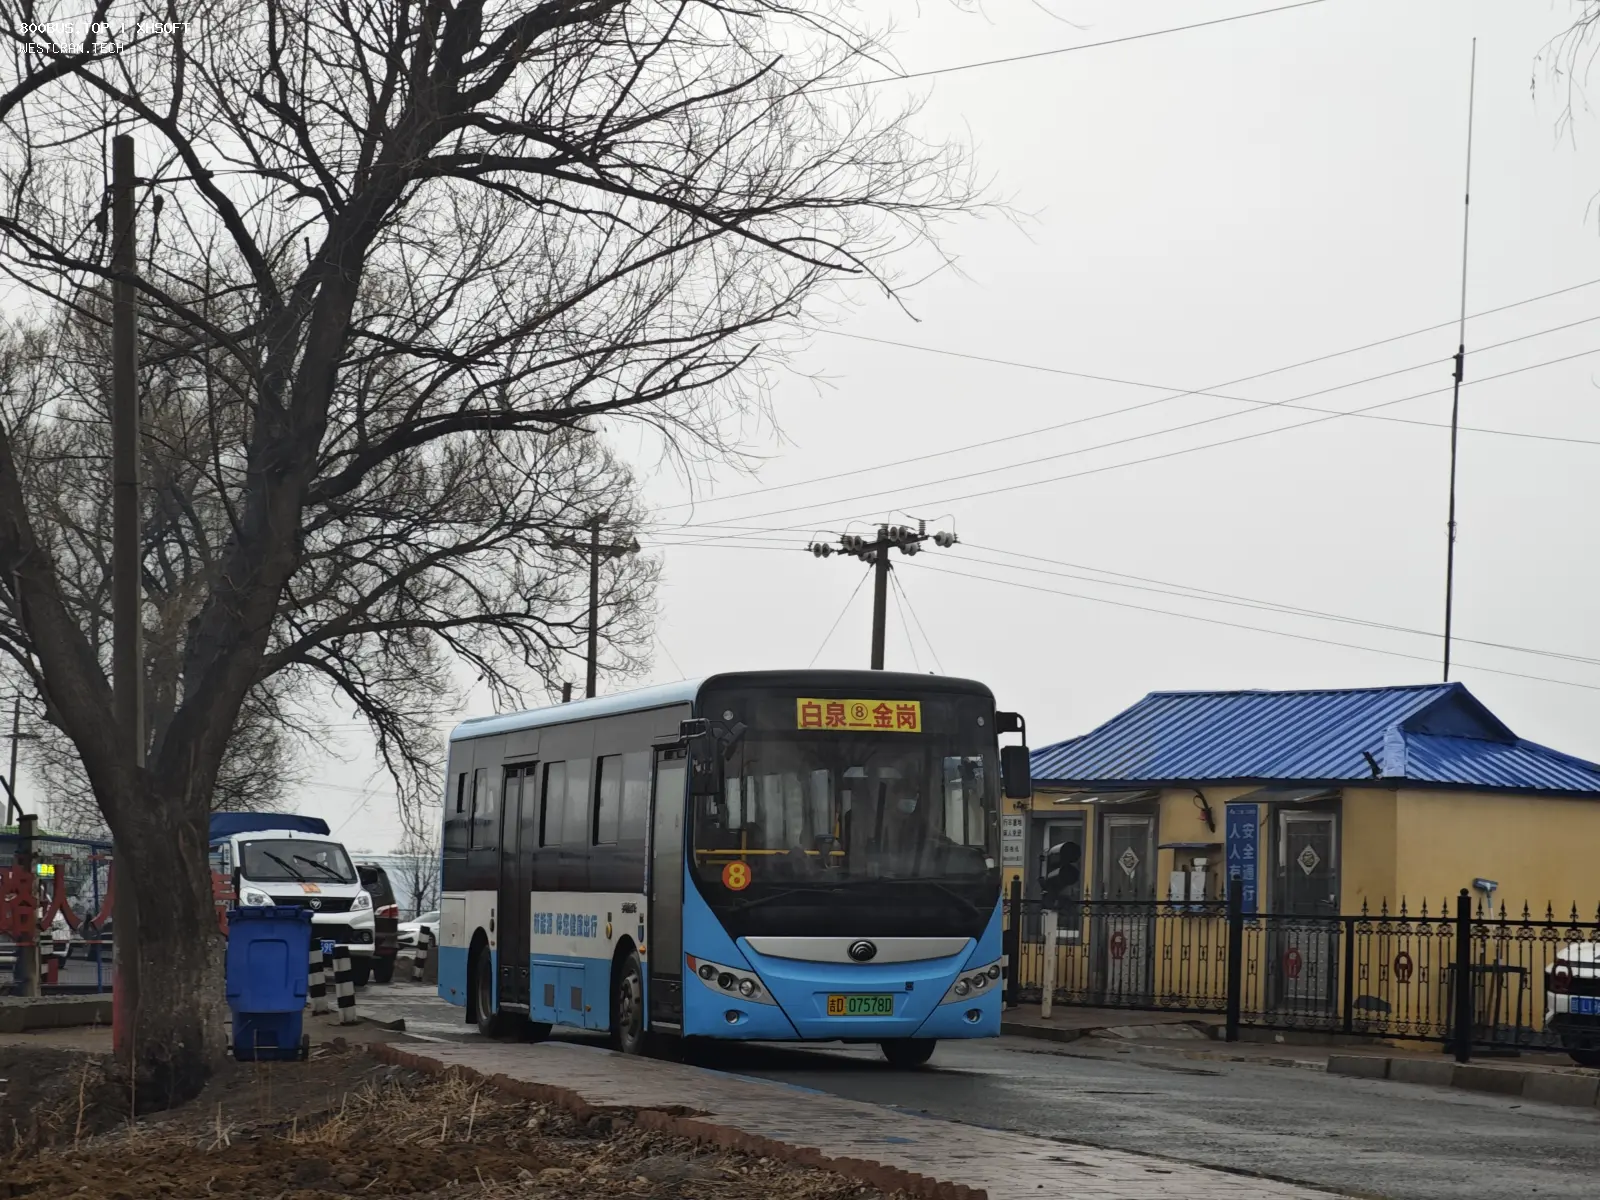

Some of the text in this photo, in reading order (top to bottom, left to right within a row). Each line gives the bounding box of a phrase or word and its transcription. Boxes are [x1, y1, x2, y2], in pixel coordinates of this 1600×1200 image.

[729, 864, 745, 887] 8
[1229, 823, 1241, 882] 人人有
[1242, 823, 1255, 901] 安全通行
